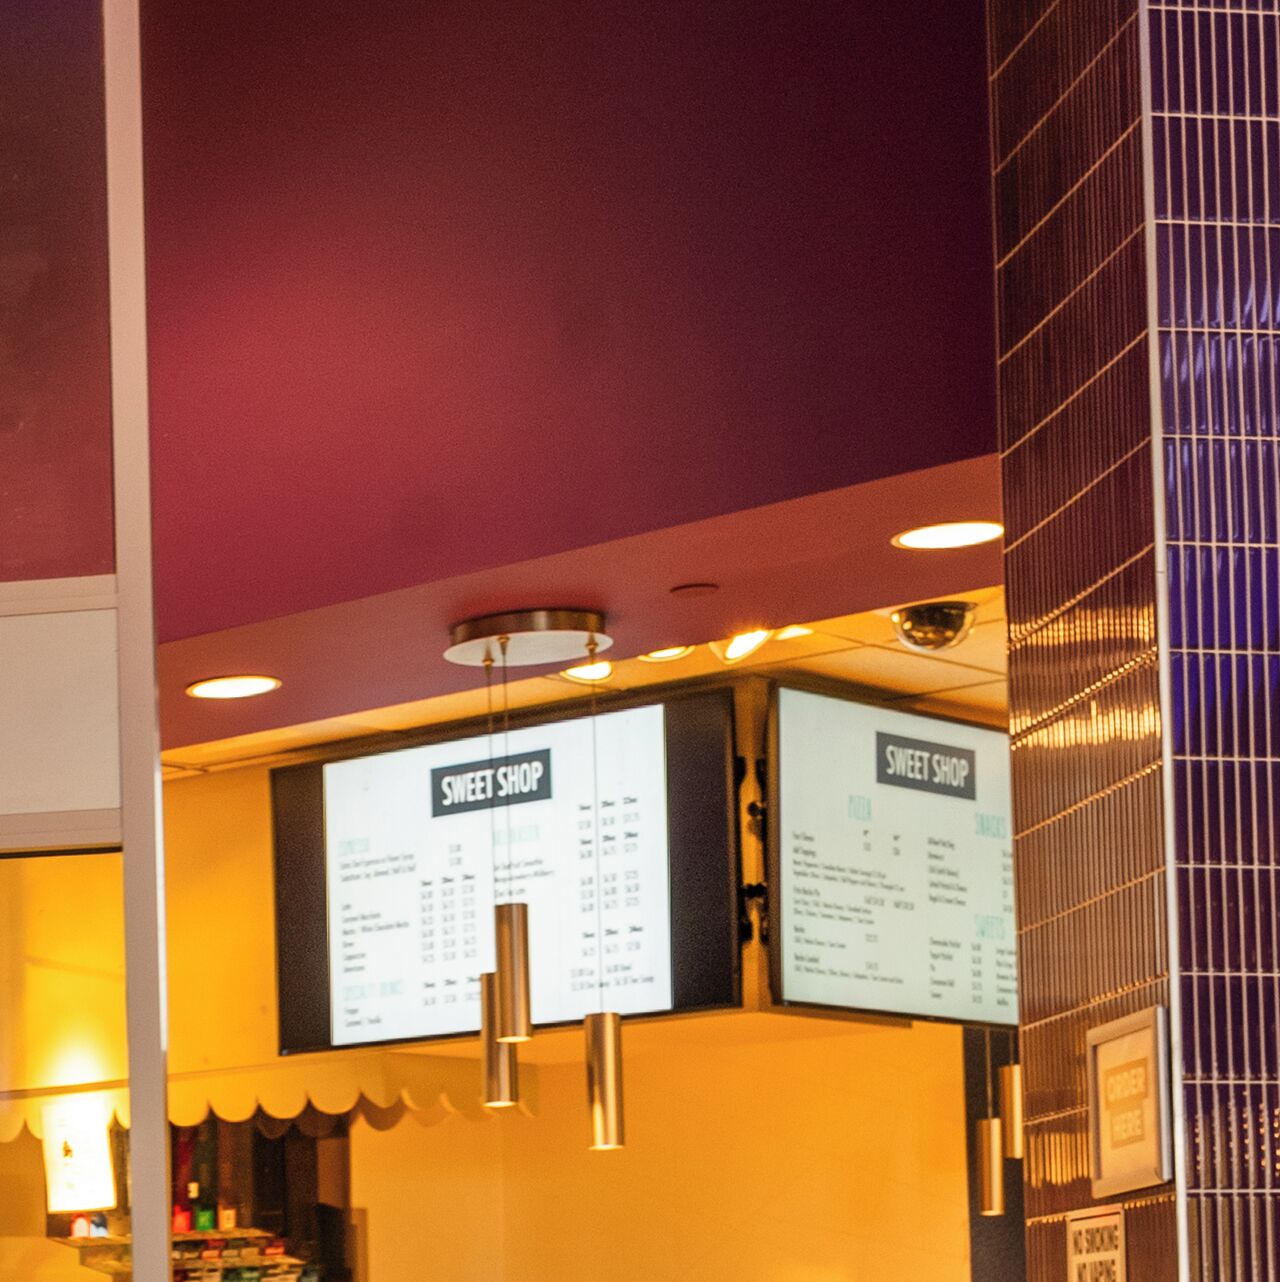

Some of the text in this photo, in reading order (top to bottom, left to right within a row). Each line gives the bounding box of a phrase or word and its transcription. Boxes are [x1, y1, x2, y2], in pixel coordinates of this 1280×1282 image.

[441, 760, 544, 807] SWEET SHOP
[885, 745, 970, 788] SWEET SHOP
[1073, 1223, 1119, 1256] NO SMOKING
